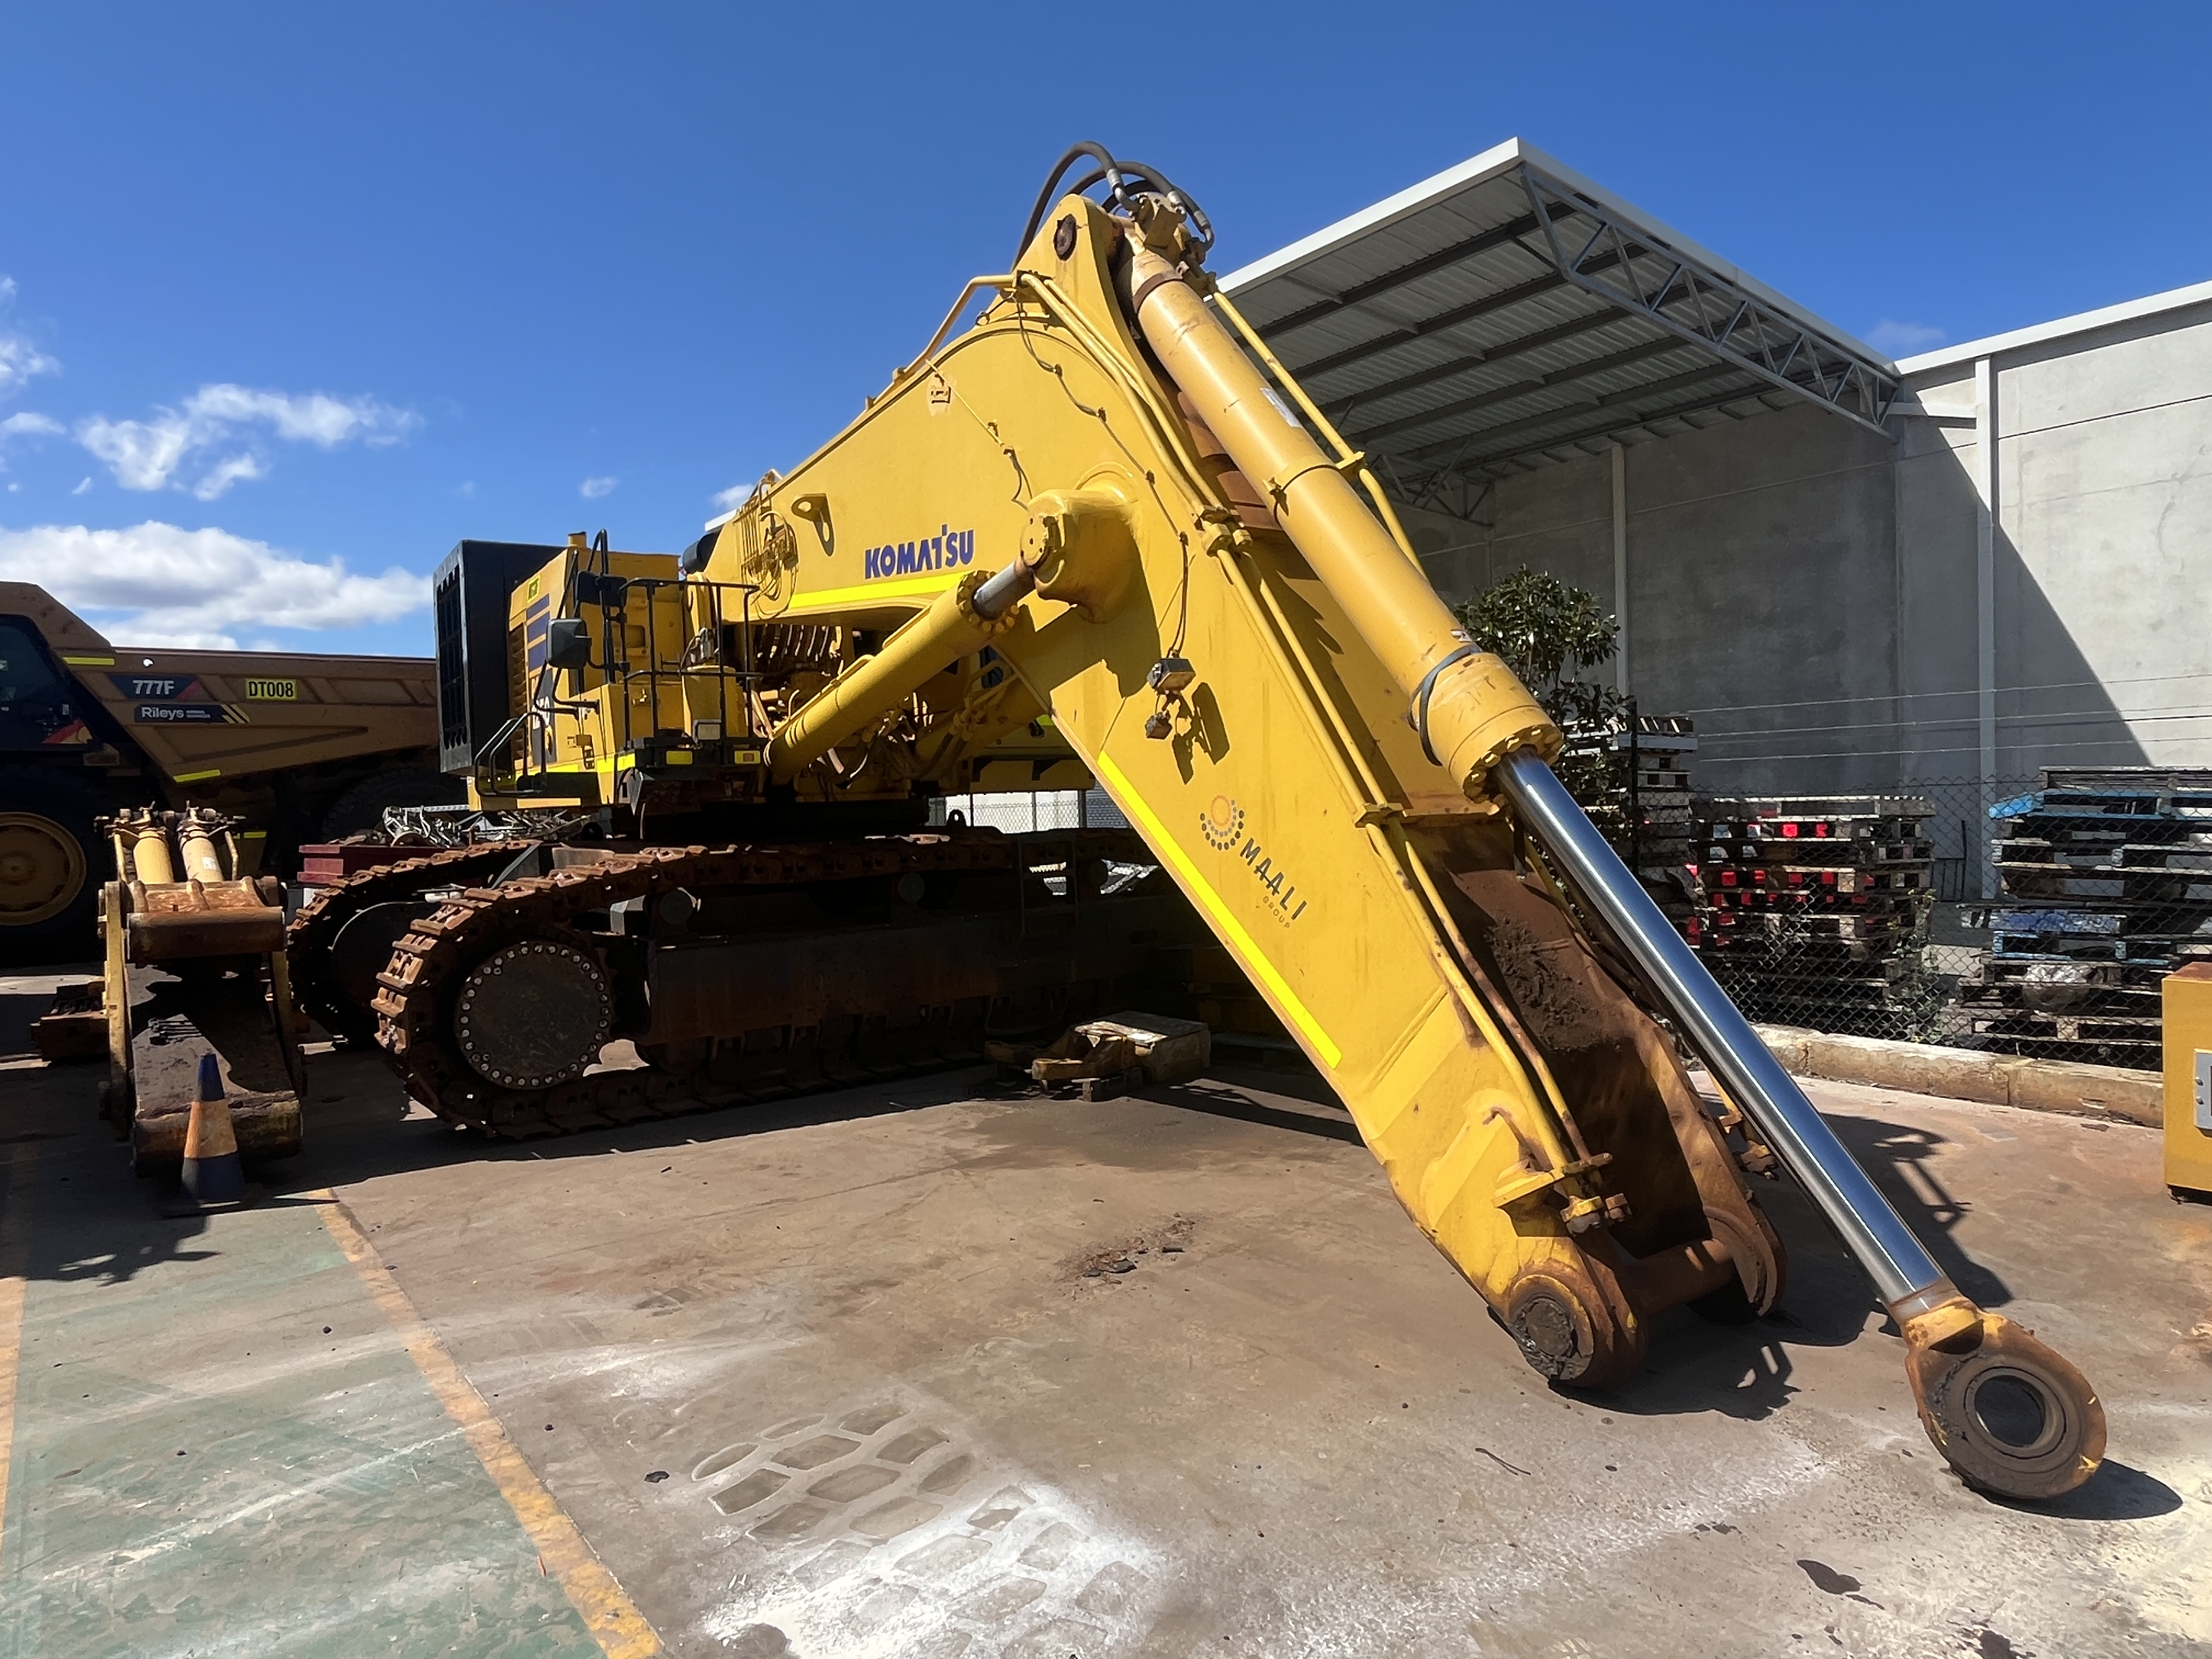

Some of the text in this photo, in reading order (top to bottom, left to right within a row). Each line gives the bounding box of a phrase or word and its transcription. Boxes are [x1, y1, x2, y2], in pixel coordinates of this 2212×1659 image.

[865, 524, 974, 579] KOMATSU
[133, 680, 174, 695] 777F
[249, 681, 294, 697] DT008
[142, 707, 184, 720] Rileys
[1240, 837, 1307, 920] MAALI
[1263, 895, 1290, 928] GROUP
